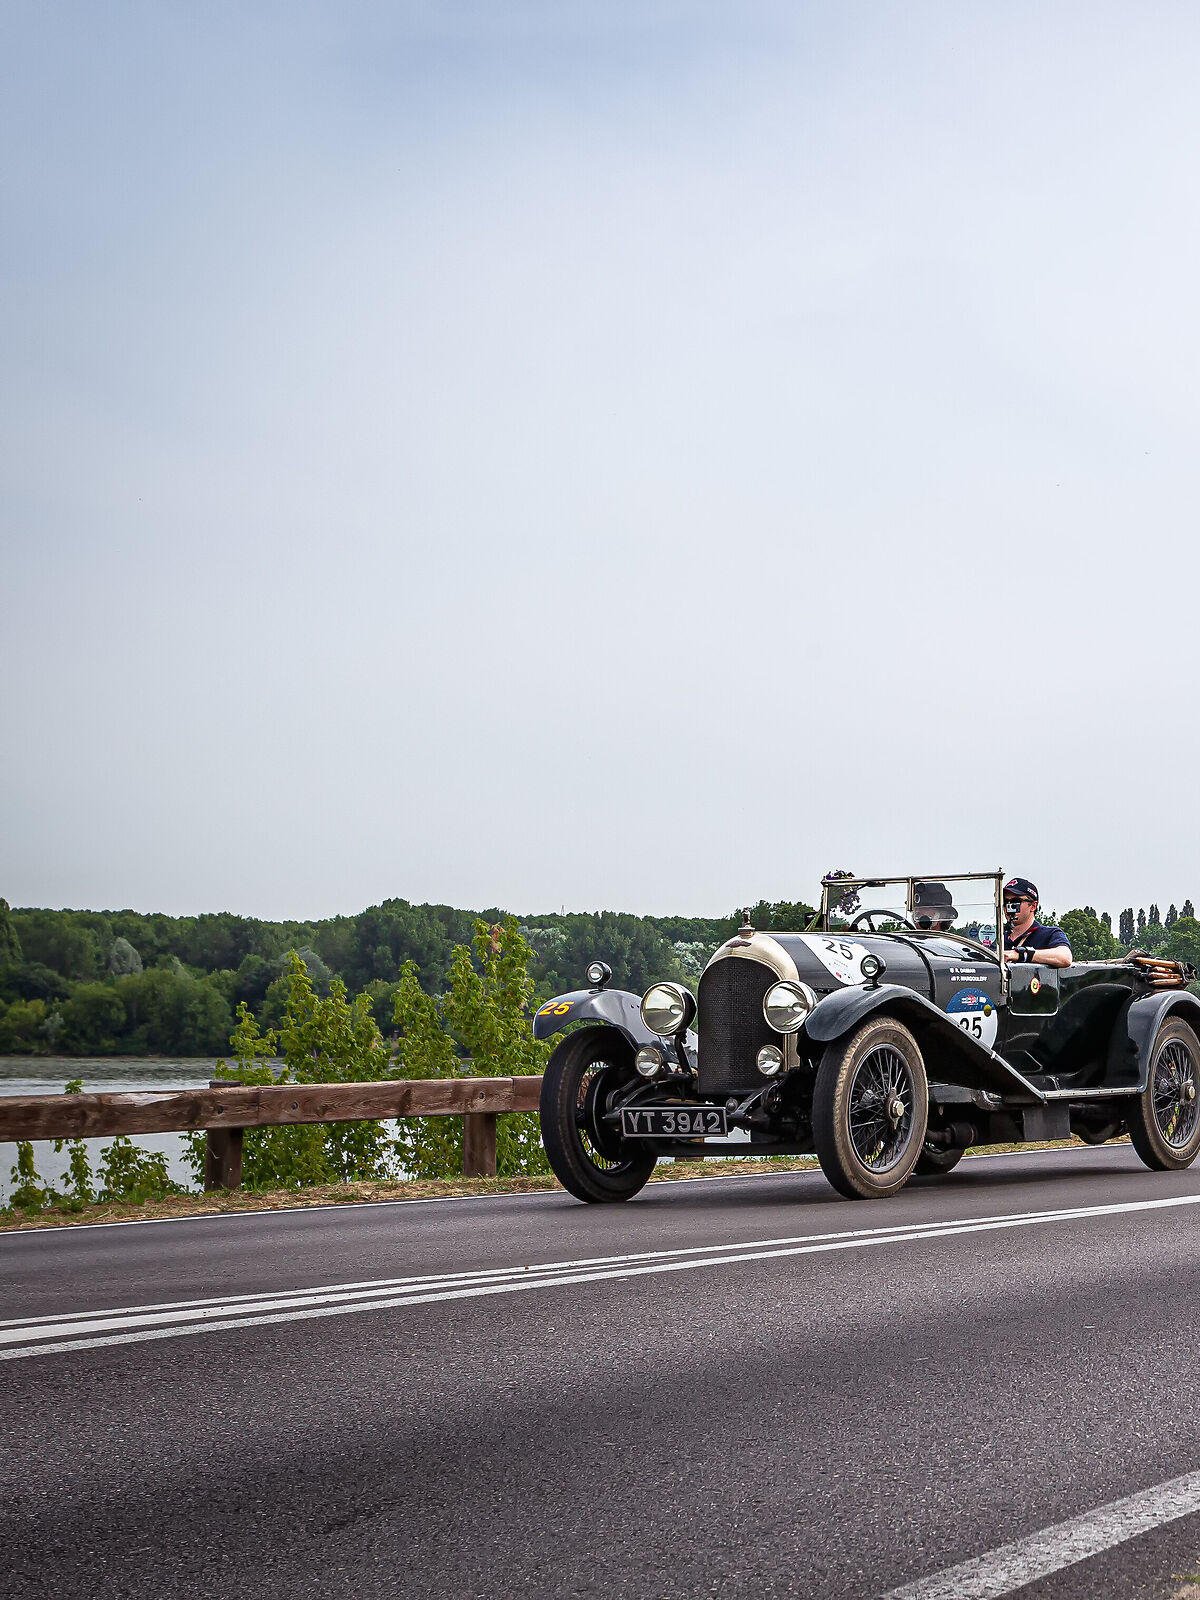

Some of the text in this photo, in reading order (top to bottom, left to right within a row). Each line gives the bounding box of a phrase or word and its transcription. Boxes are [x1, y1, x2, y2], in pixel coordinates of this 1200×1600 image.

[821, 939, 853, 961] 25
[538, 1001, 575, 1016] 25
[627, 1111, 721, 1133] YT 3942
